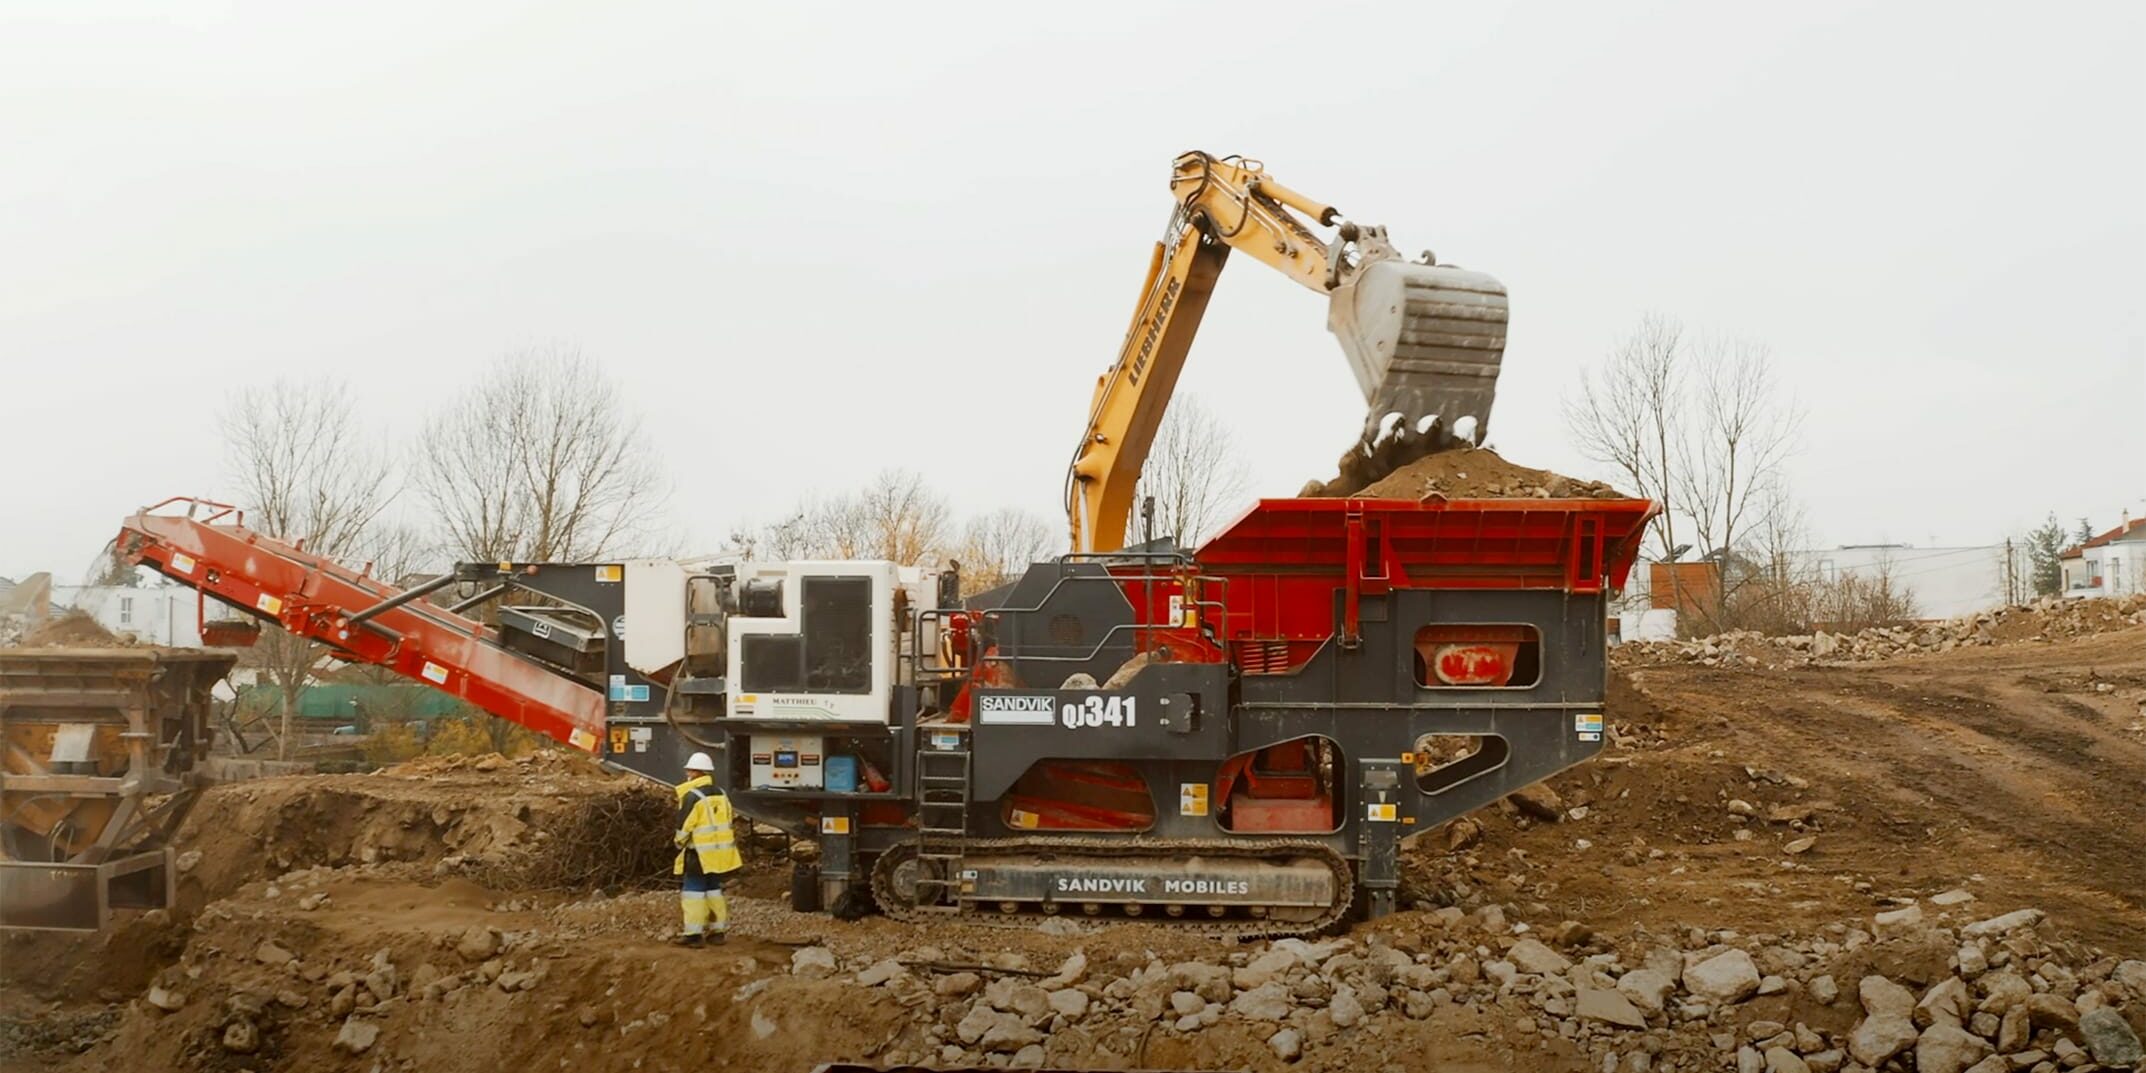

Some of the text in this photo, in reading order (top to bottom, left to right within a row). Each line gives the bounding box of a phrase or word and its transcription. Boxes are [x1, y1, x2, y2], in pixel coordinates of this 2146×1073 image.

[1128, 276, 1181, 387] LIEBHERR
[982, 697, 1053, 711] SANDVIK
[1062, 695, 1136, 729] QJ341
[1058, 878, 1249, 894] SANDVIK MOBILES
